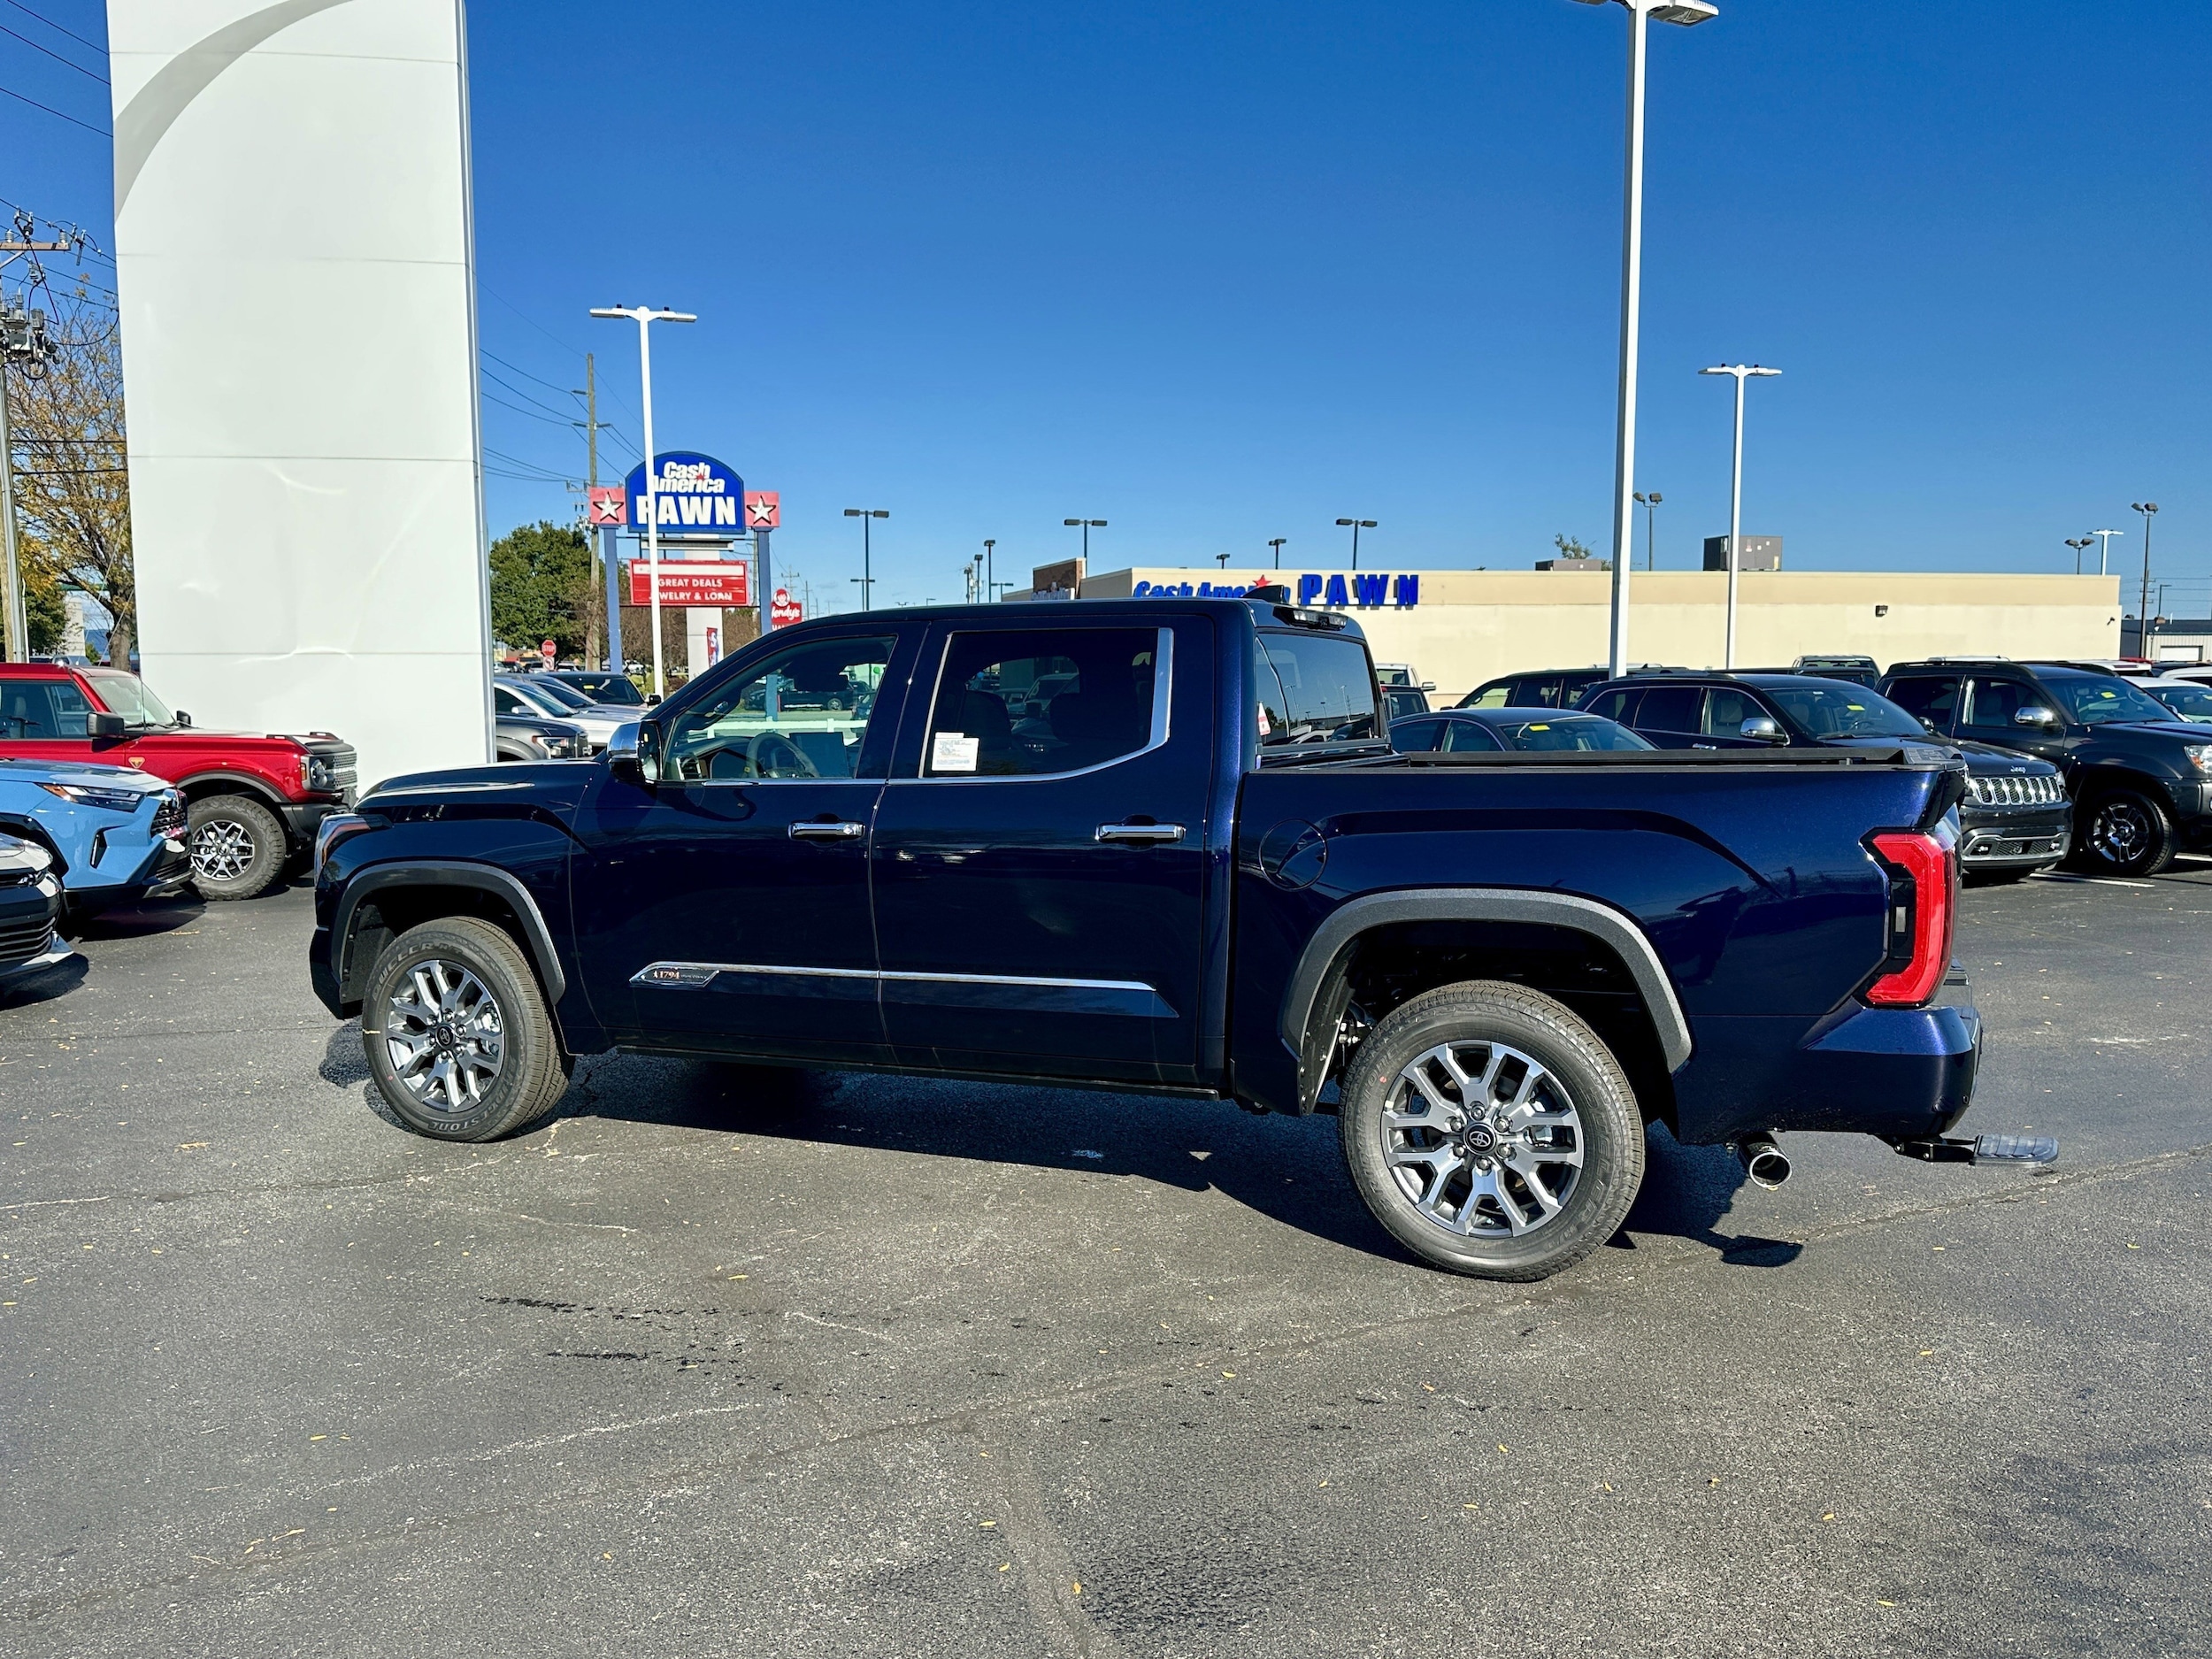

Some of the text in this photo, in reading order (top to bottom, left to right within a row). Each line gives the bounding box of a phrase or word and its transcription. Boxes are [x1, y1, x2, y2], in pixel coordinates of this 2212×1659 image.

[664, 461, 710, 479] Cash
[636, 495, 736, 525] PAWN
[658, 579, 723, 588] GREAT DEALS
[1133, 580, 1194, 597] Cash
[1301, 574, 1418, 605] PAWN
[704, 592, 733, 601] LOAN
